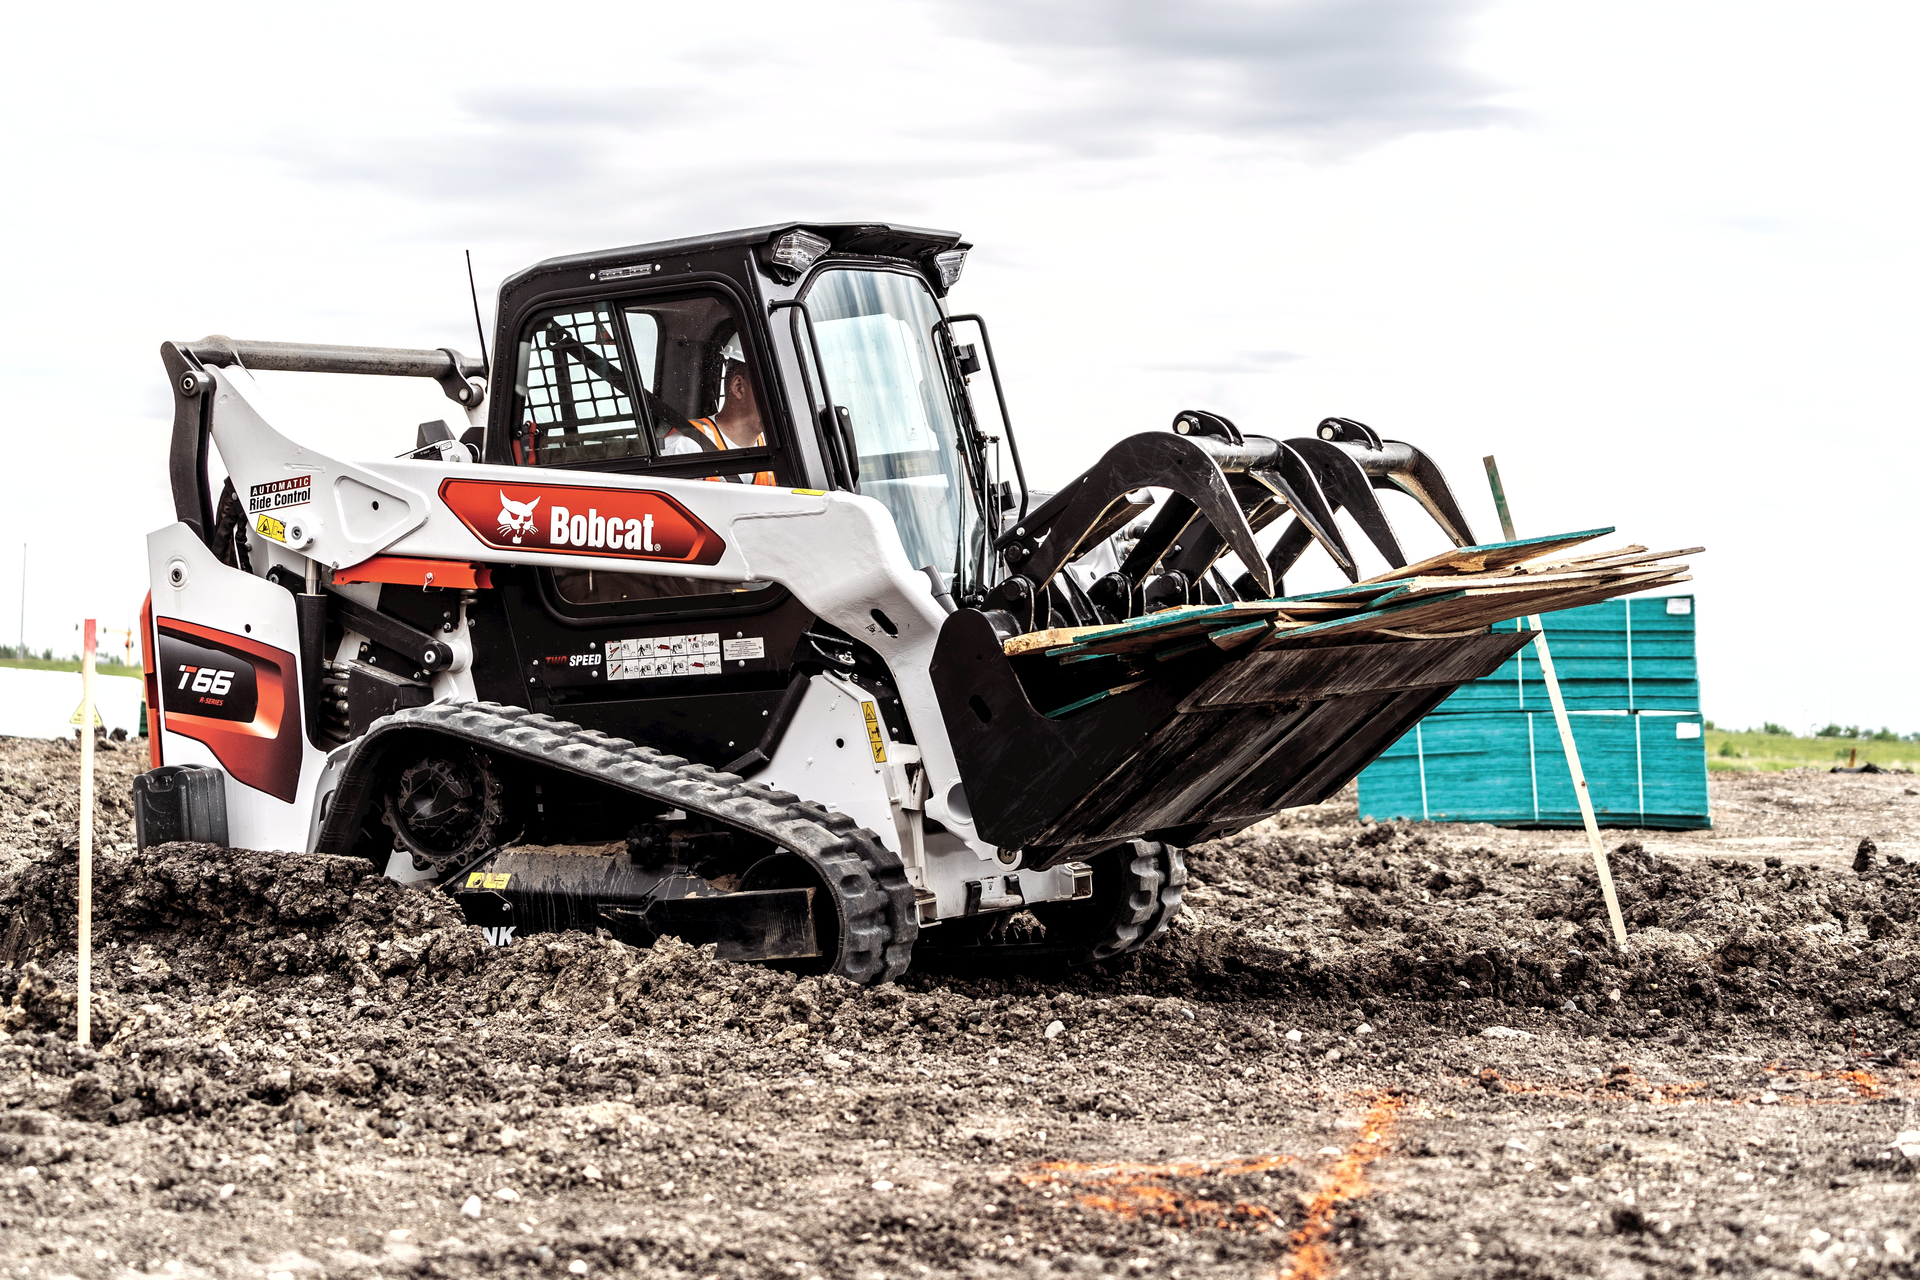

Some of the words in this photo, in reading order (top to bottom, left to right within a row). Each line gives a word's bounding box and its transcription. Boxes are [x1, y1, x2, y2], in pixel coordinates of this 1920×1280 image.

[252, 477, 309, 496] AUTOMATIC
[250, 496, 272, 511] Ride
[274, 487, 311, 507] Control
[545, 655, 568, 666] TWO
[569, 653, 602, 667] SPEED
[177, 664, 236, 696] T66
[199, 696, 224, 707] R-SERIES
